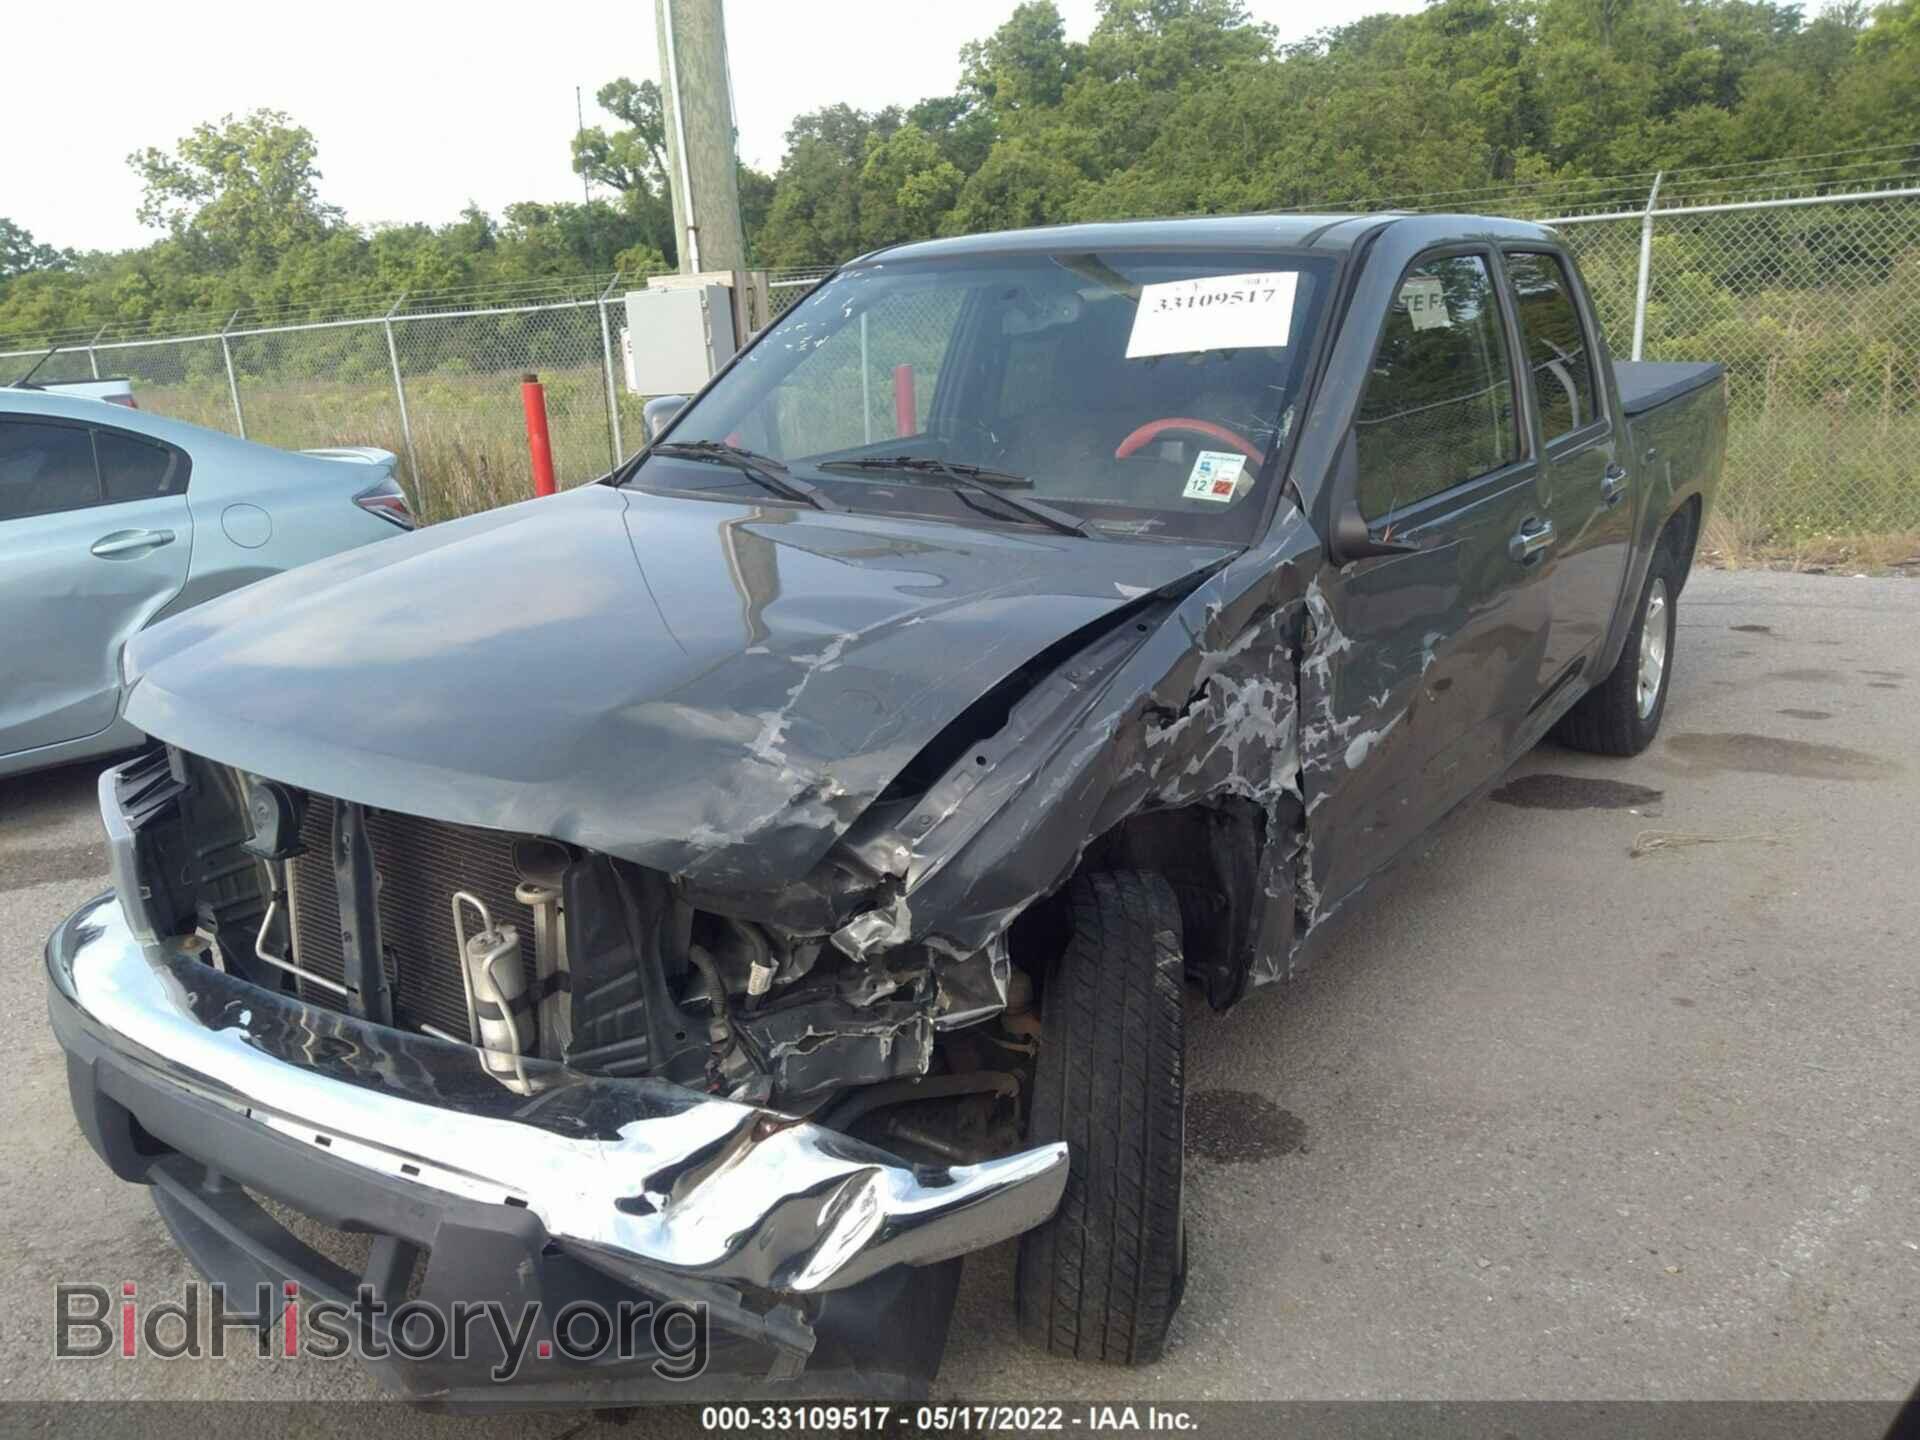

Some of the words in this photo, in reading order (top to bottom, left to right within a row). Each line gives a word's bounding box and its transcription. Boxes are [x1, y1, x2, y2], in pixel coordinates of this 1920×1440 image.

[1153, 289, 1276, 313] 33109517
[1191, 479, 1208, 492] 12
[1213, 480, 1233, 494] 22
